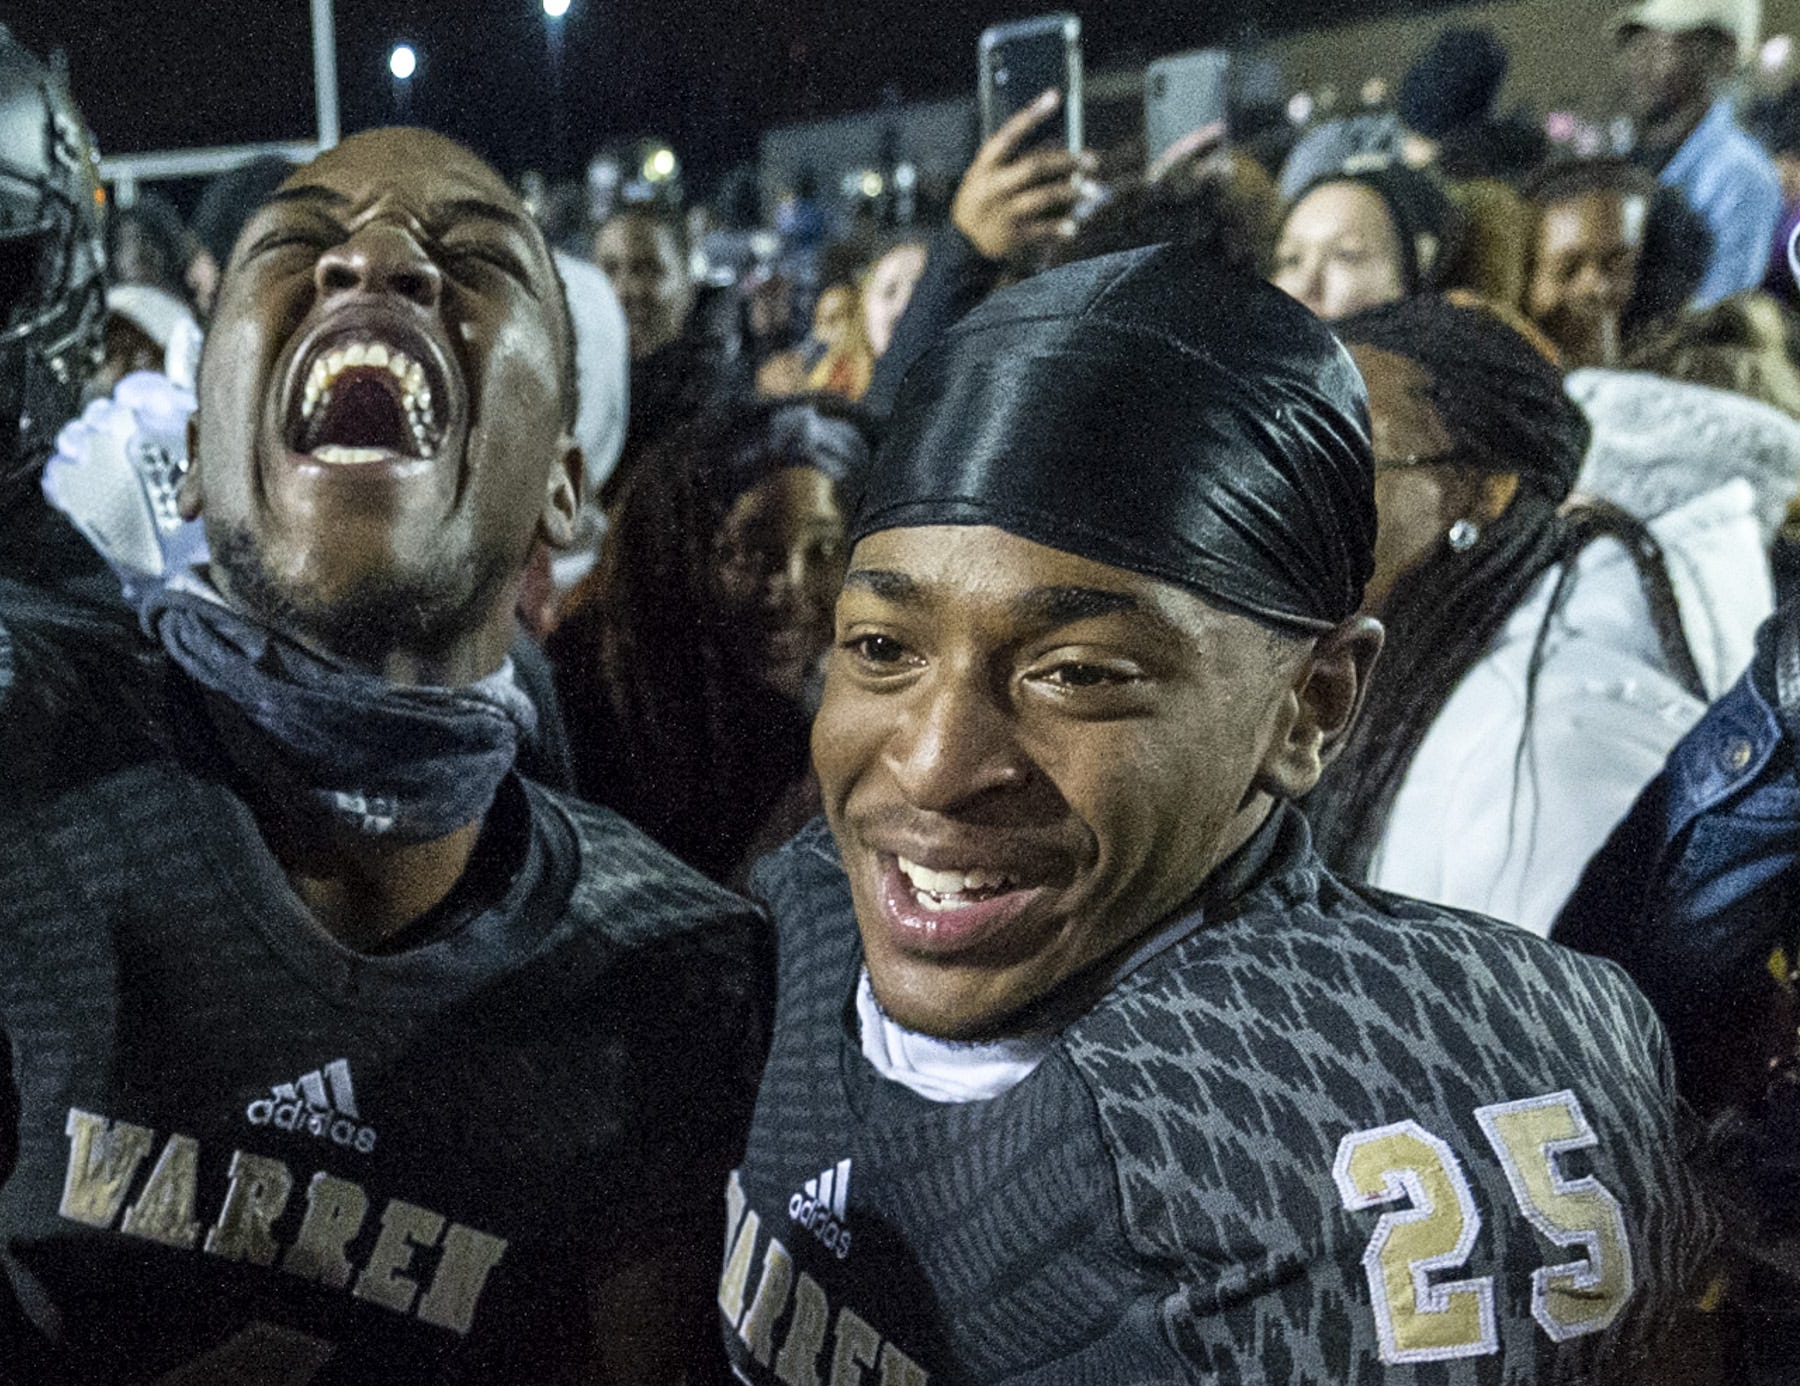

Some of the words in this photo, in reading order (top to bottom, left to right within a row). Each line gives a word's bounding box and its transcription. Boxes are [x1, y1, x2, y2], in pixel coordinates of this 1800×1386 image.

[246, 1099, 378, 1154] adidas
[58, 1106, 509, 1337] WARREN
[788, 1192, 852, 1260] adidas
[1331, 1088, 1636, 1366] 25
